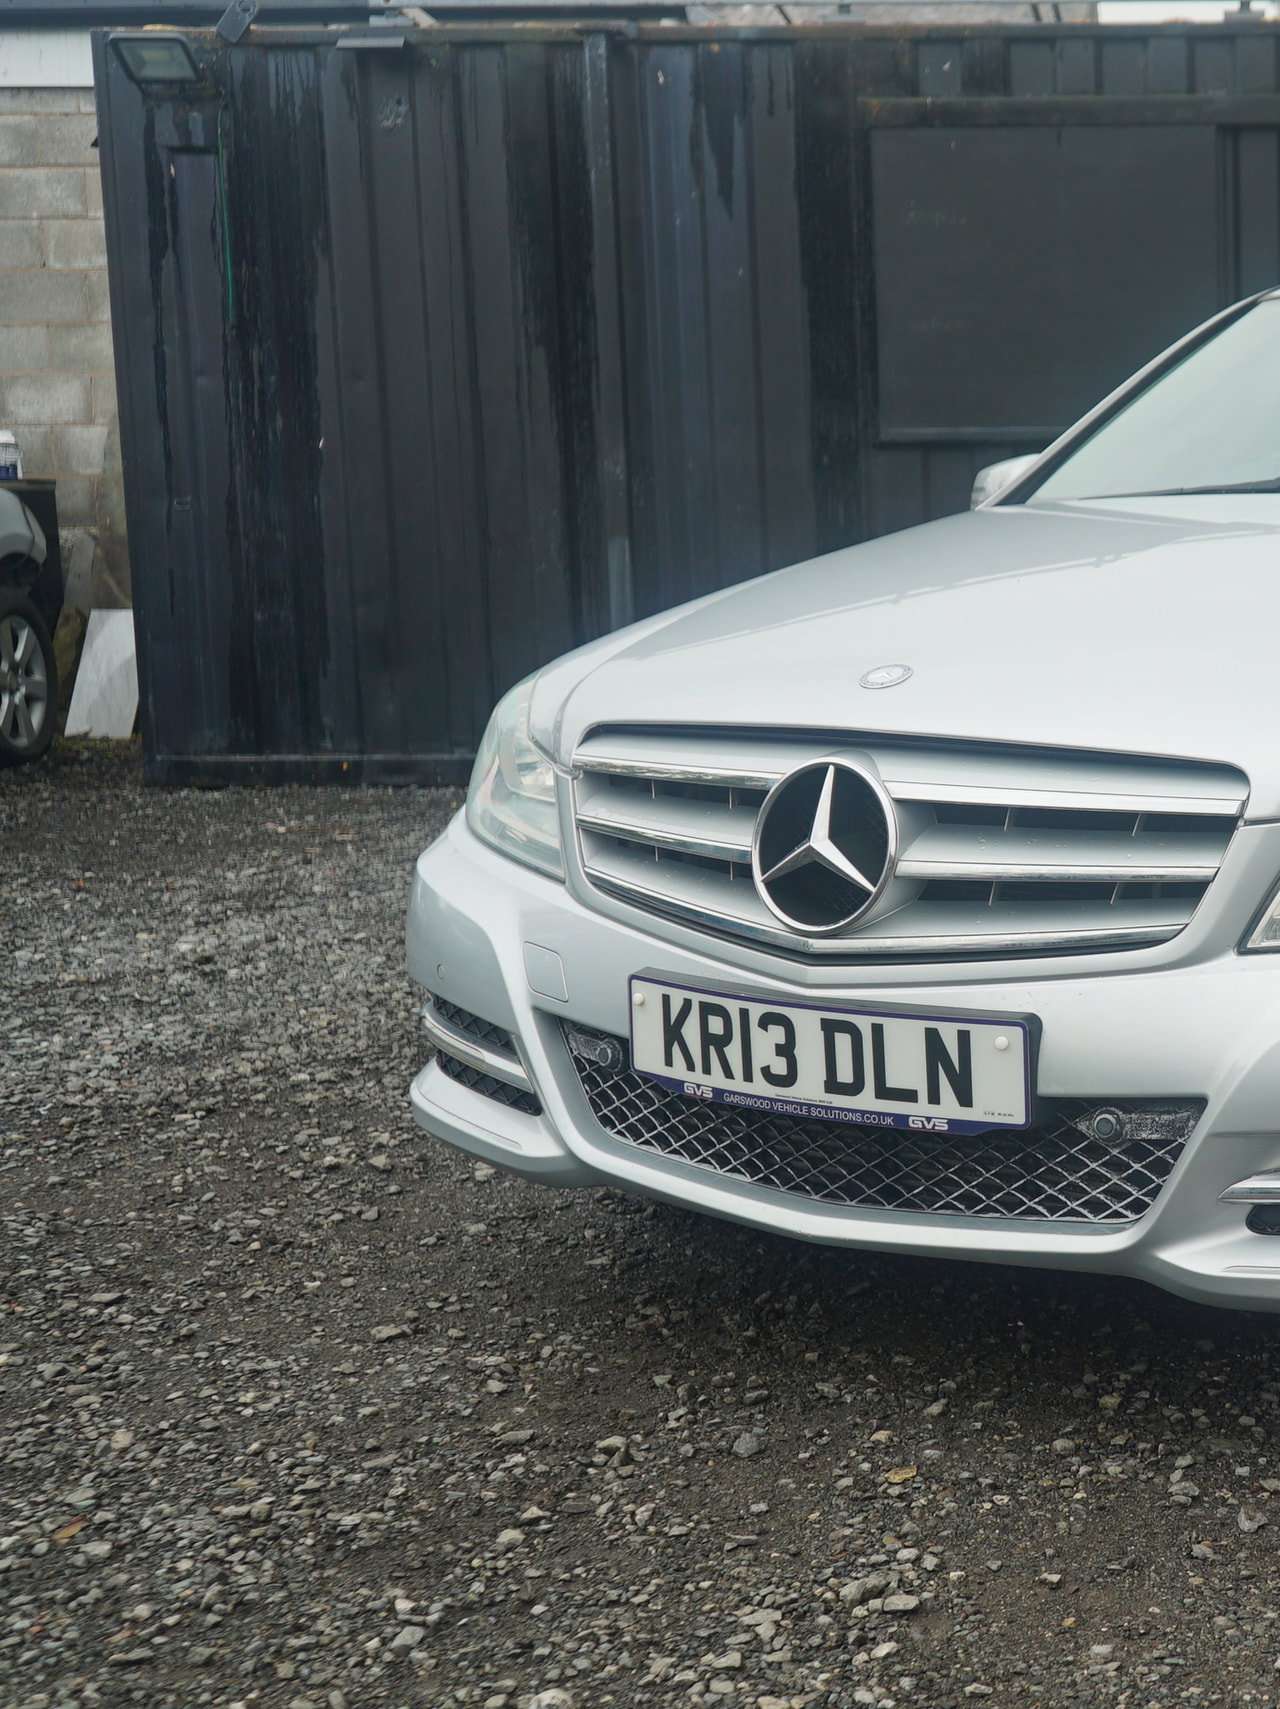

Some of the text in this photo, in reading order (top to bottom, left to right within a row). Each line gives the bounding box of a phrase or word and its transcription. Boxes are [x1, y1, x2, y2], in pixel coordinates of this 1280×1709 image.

[662, 993, 974, 1109] KR13 DLN
[683, 1082, 713, 1098] GVS
[723, 1092, 770, 1109] GARSWOOD
[772, 1101, 809, 1115] VEHICLE
[810, 1107, 895, 1126] SOLUTIONS.CO.UK
[908, 1116, 949, 1131] GVS
